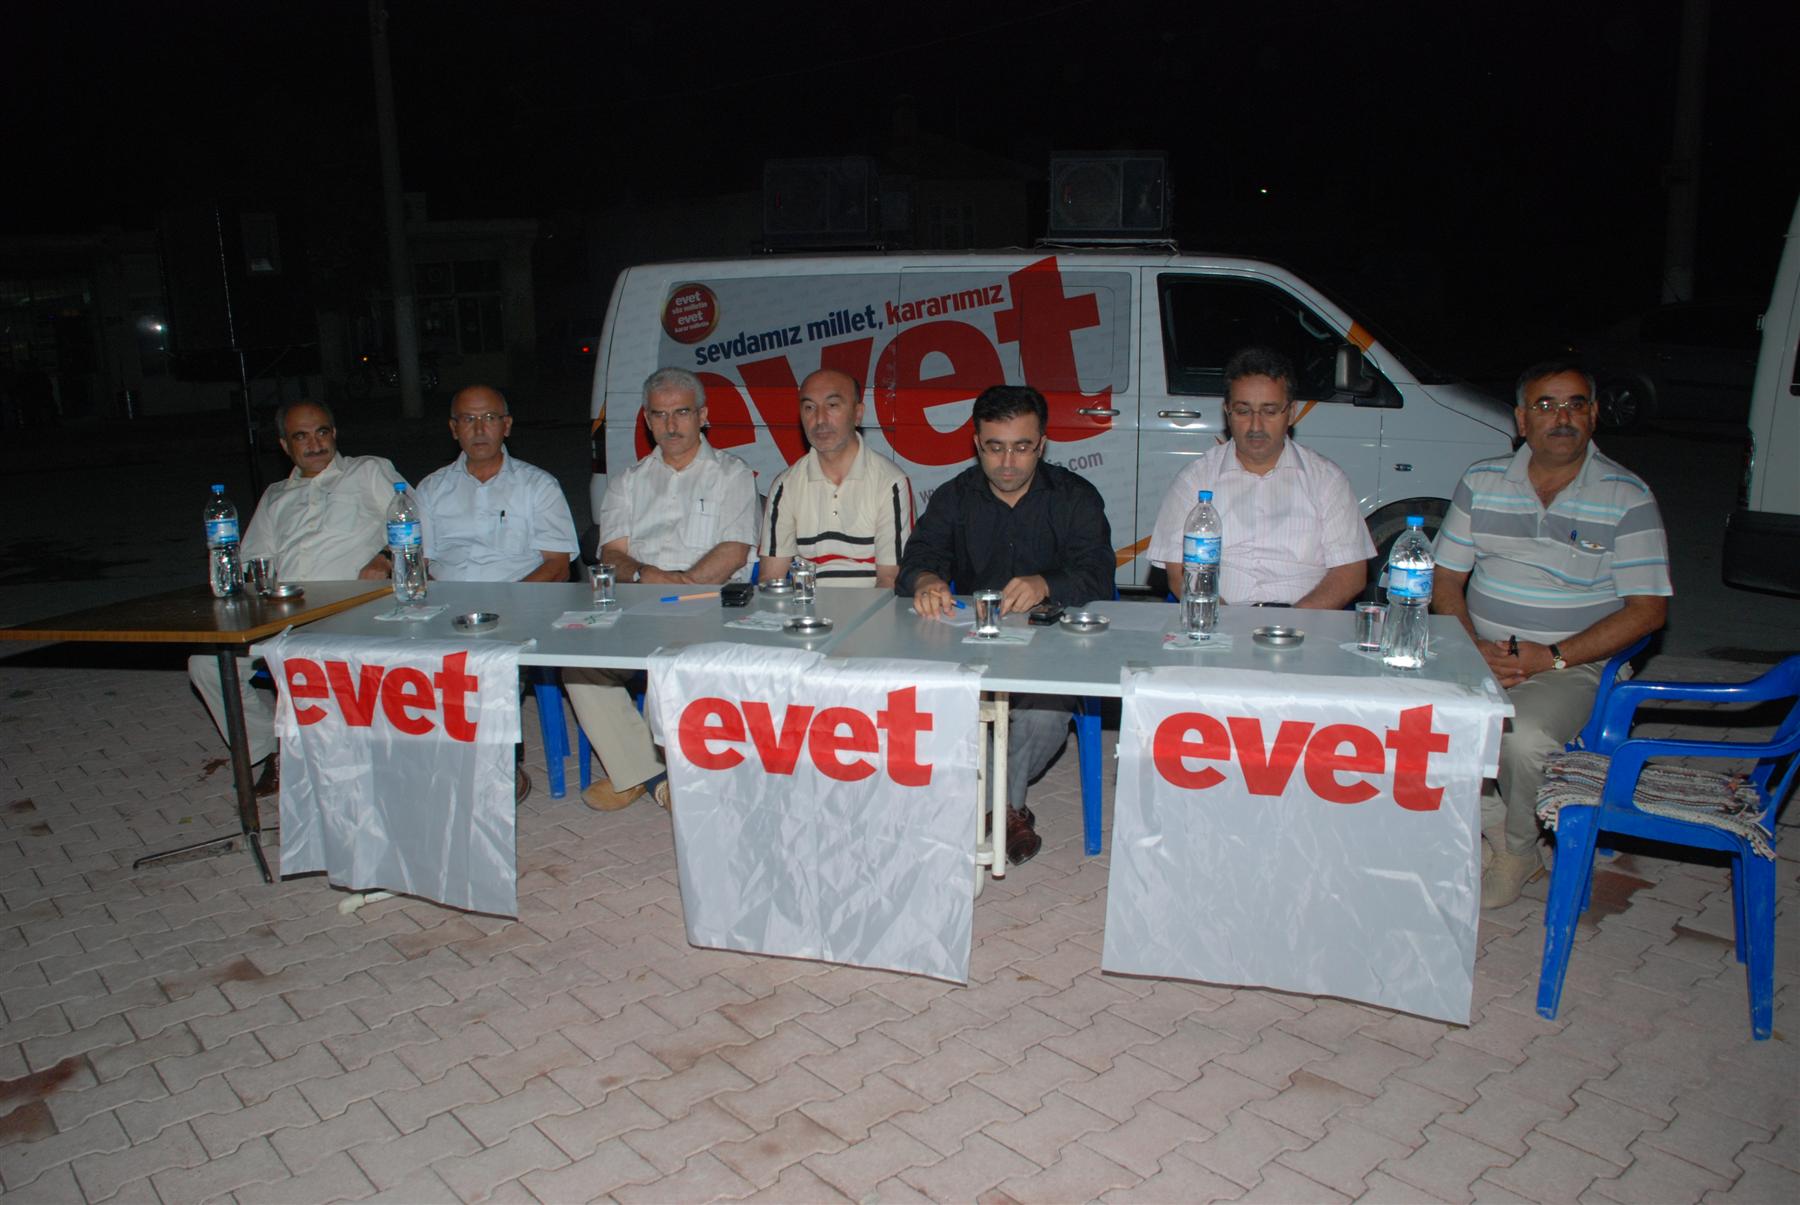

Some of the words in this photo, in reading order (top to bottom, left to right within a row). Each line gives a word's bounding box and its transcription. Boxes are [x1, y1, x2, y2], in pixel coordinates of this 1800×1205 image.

[675, 291, 702, 306] evet
[677, 310, 704, 325] evet
[695, 326, 803, 366] sevdamız
[807, 303, 884, 342] millet,
[886, 283, 1004, 326] kararımız
[634, 256, 1113, 478] evet
[284, 650, 478, 742] evet
[678, 685, 933, 787] evet
[1153, 704, 1450, 812] evet
